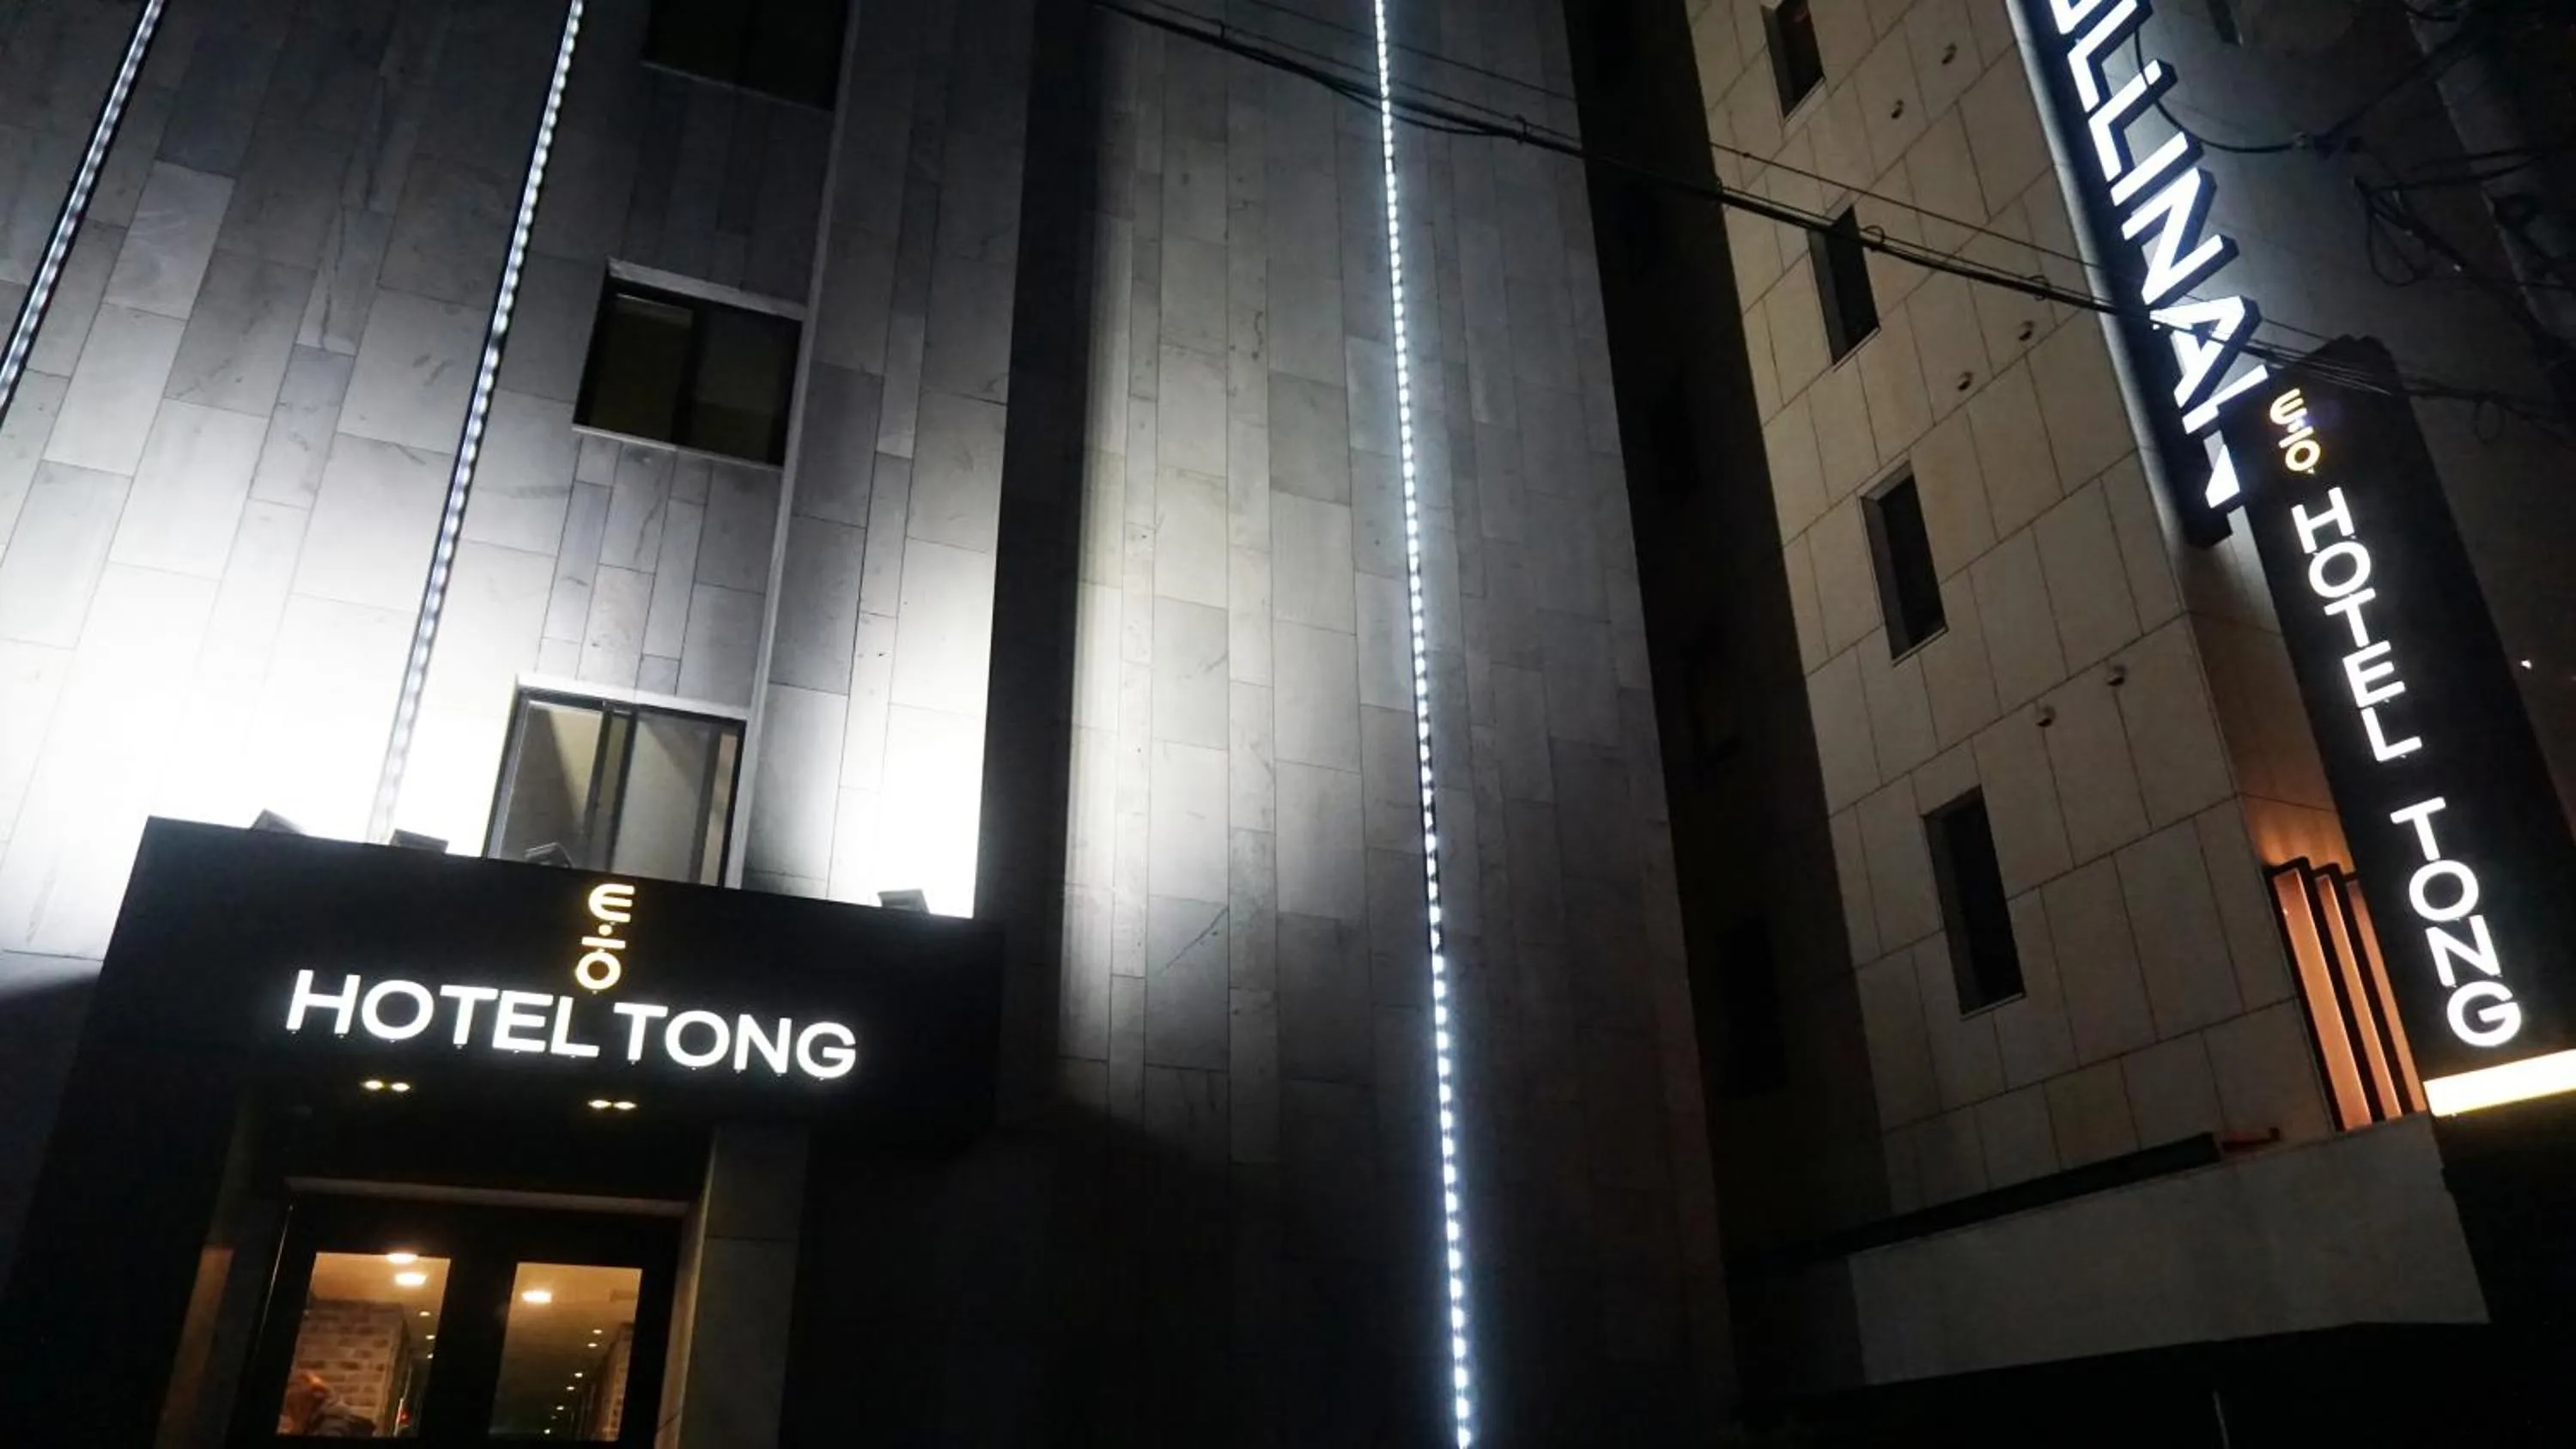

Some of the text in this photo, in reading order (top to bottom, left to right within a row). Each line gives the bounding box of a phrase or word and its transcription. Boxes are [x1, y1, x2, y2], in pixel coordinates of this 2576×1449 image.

[2291, 486, 2523, 1047] HOTEL TONG
[285, 969, 857, 1080] HOTEL TONG
